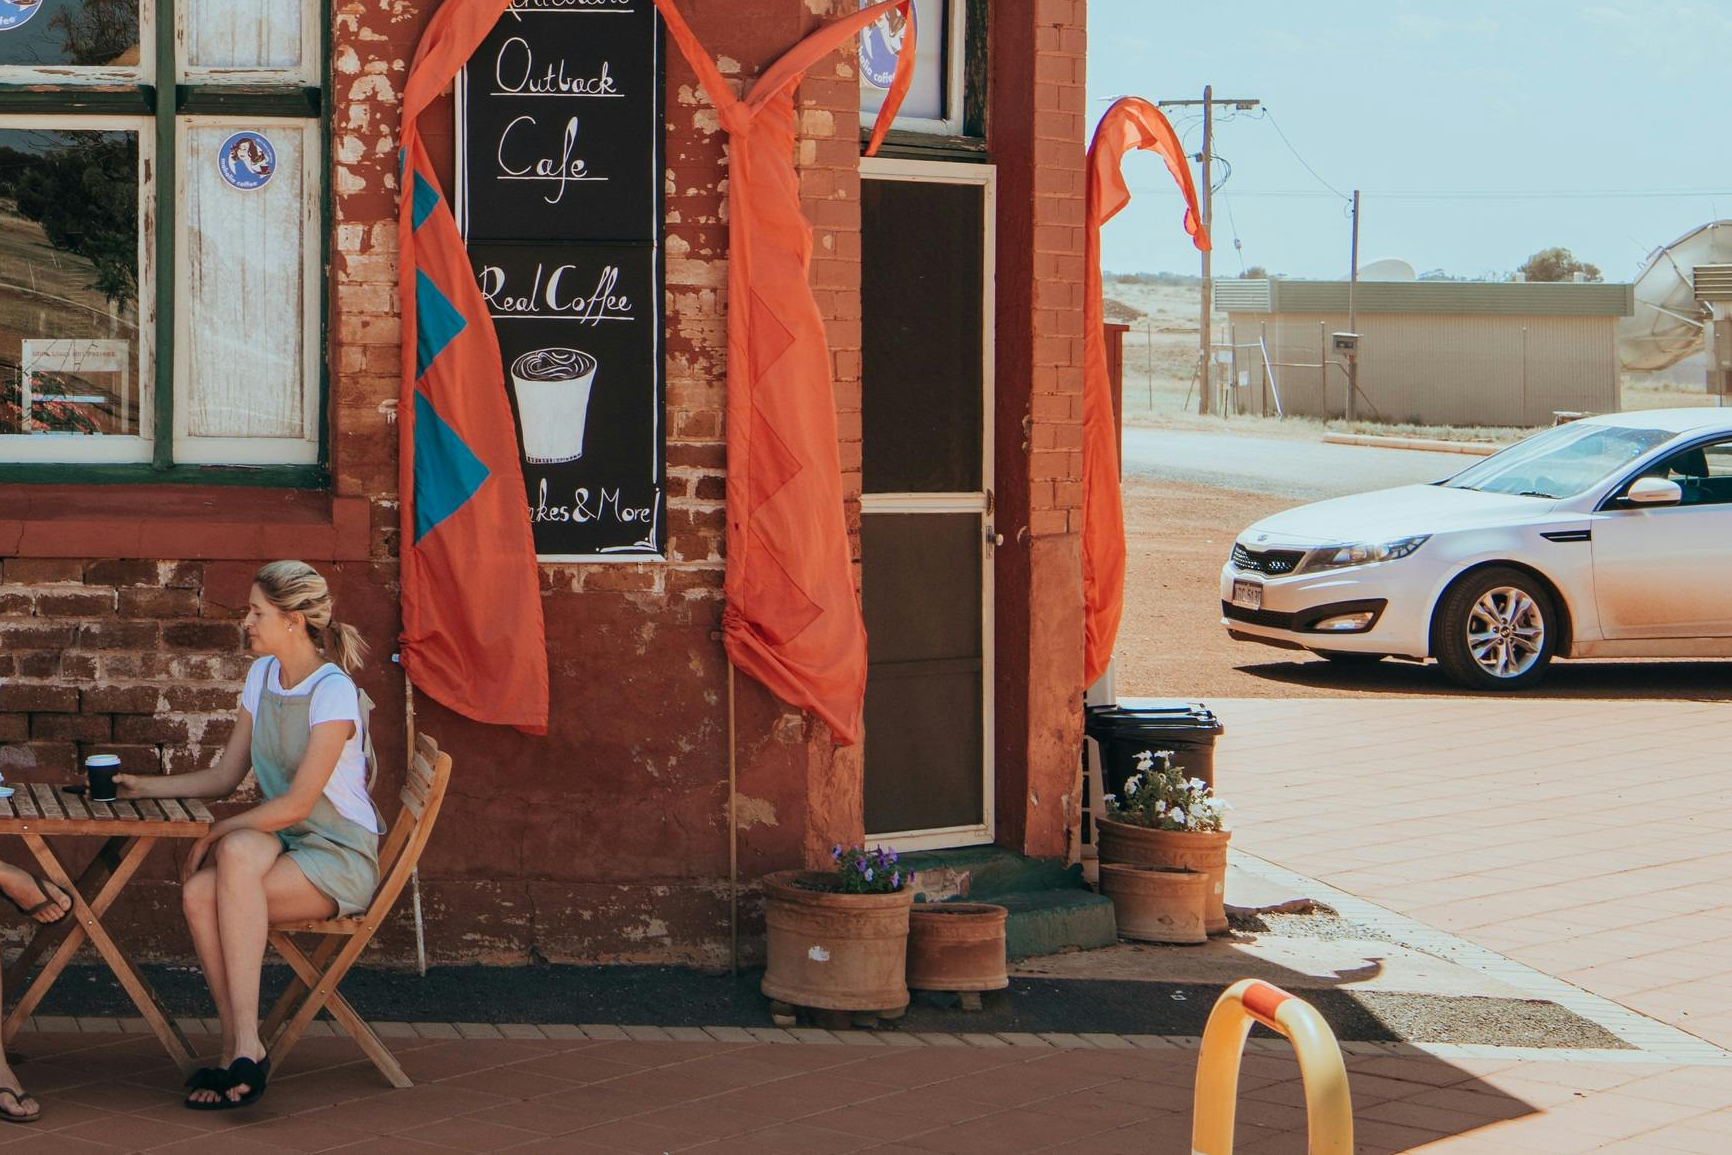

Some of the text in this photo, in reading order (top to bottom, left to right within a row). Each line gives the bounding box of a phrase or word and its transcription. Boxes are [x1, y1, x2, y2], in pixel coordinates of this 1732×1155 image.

[496, 36, 616, 95] Outback
[498, 115, 587, 204] Cafe
[478, 263, 632, 327] Real Coffee
